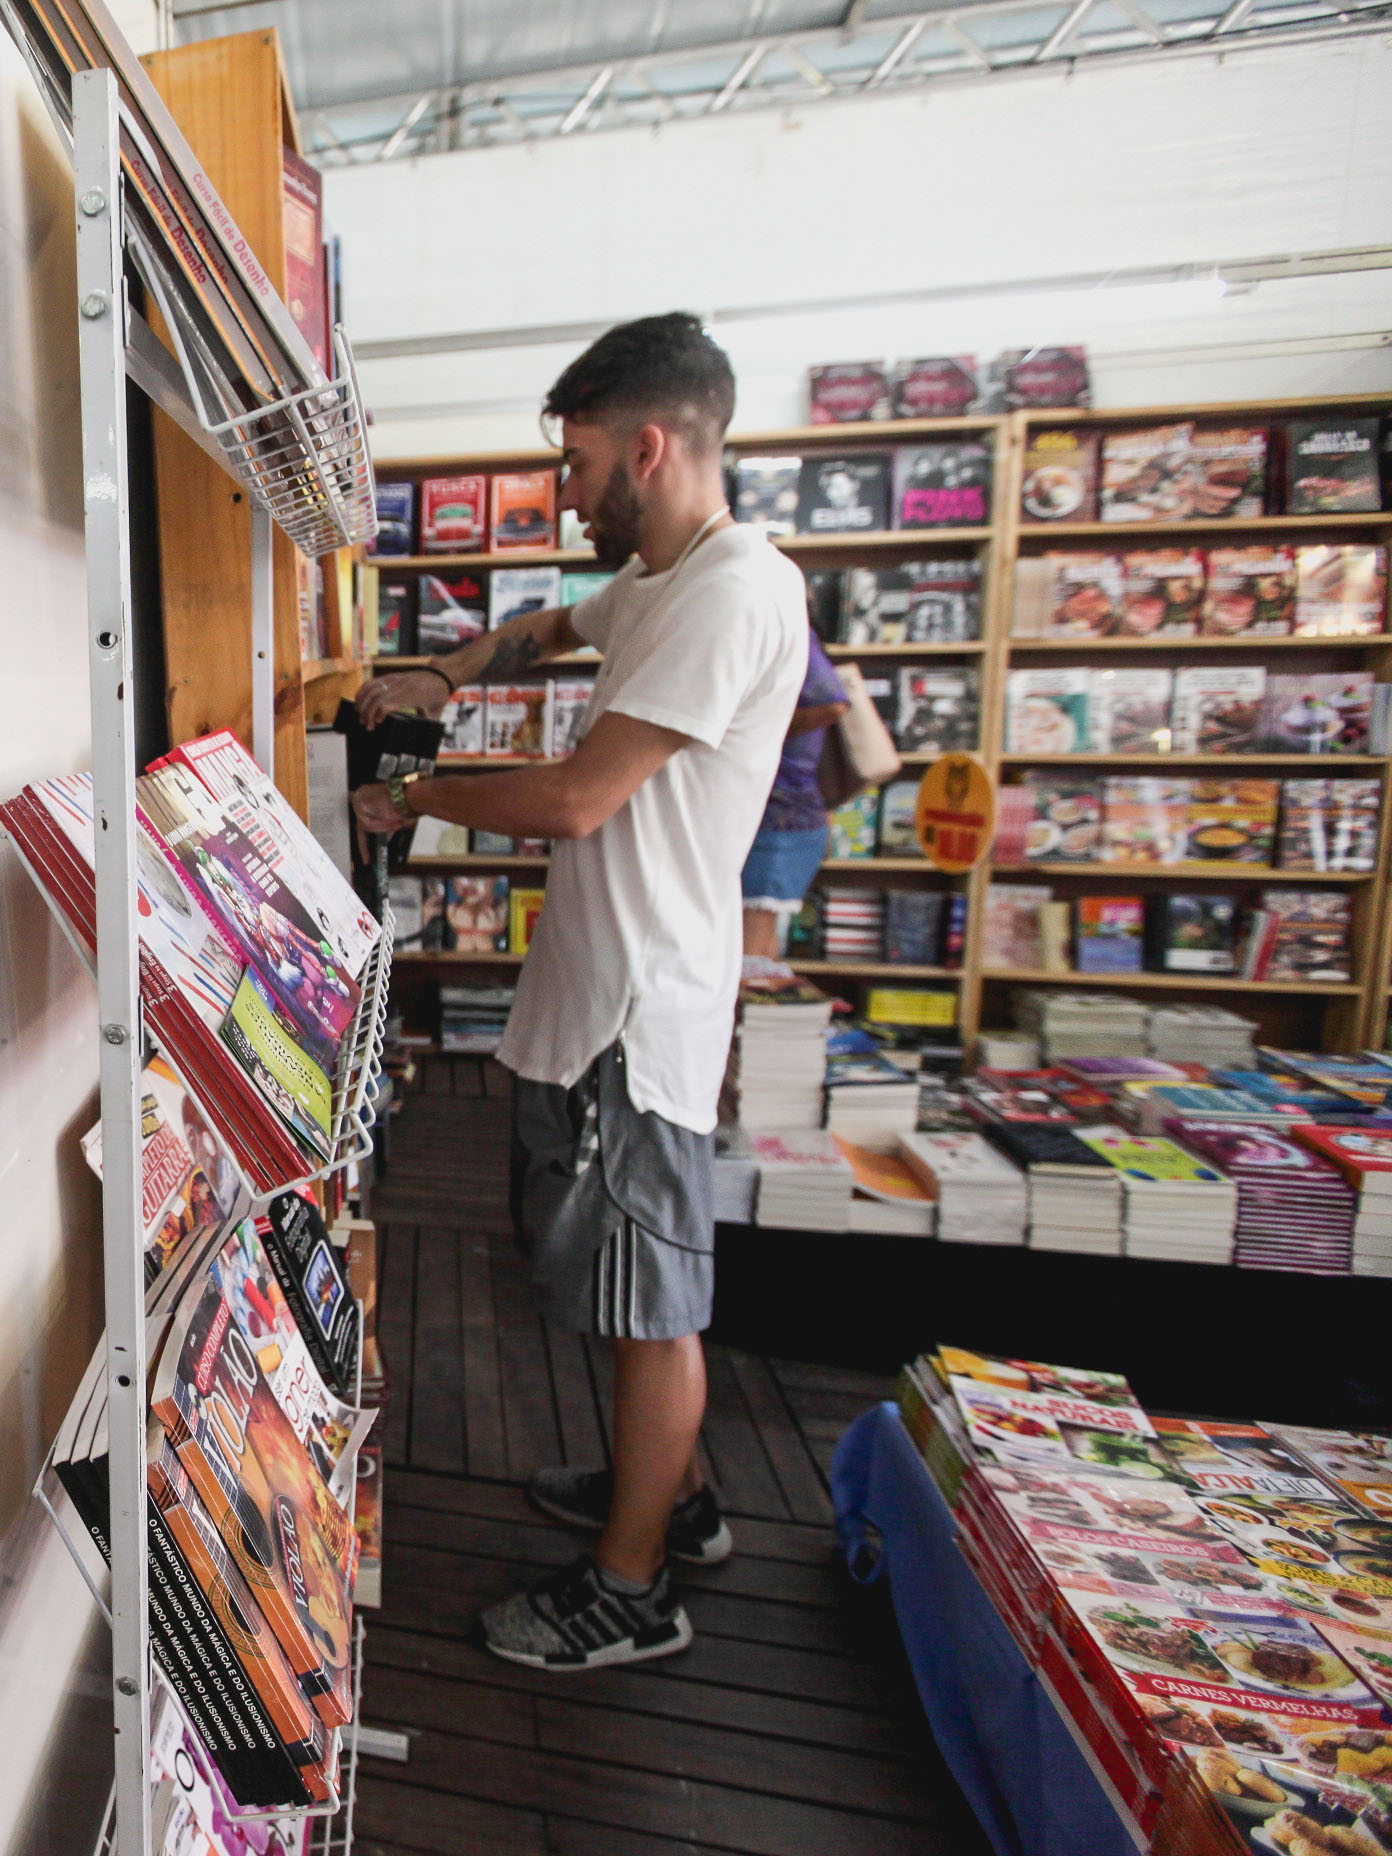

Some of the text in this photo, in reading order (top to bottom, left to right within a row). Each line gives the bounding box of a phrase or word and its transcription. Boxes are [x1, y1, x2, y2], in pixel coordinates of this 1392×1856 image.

[171, 226, 207, 284] Desenho
[193, 173, 269, 296] Curso Fácil de Desenho
[152, 980, 164, 995] Steps
[159, 970, 174, 985] Steps
[159, 994, 170, 1002] 3
[167, 985, 177, 993] 3
[149, 999, 159, 1007] 3
[268, 1249, 288, 1277] Manual
[280, 1276, 290, 1288] da
[195, 1302, 230, 1390] CURSO COMPLETO
[203, 1328, 258, 1482] VIOLÃO
[1010, 1400, 1140, 1431] NATURAIS
[1048, 1398, 1133, 1421] SUCOS
[90, 1525, 100, 1535] O
[281, 1503, 308, 1607] VIOLÃO
[149, 1519, 276, 1749] O FANTÁSTICO MUNDO DA MÁGICA E DO ILUSIONISMO
[163, 1621, 175, 1637] DA
[171, 1636, 194, 1672] MÁGICA
[190, 1671, 198, 1680] E
[194, 1679, 206, 1694] DO
[202, 1691, 236, 1751] ILUSIONISMO
[164, 1584, 186, 1619] MUNDO
[182, 1619, 193, 1634] DA
[190, 1633, 212, 1670] MÁGICA
[209, 1669, 217, 1678] E
[213, 1677, 225, 1692] DO
[221, 1689, 256, 1749] ILUSIONISMO
[152, 1637, 174, 1673] MÁGICA
[171, 1672, 179, 1681] E
[175, 1680, 187, 1695] DO
[183, 1693, 217, 1750] ILUSIONISMO
[1151, 1679, 1359, 1721] CARNES VERMELHAS
